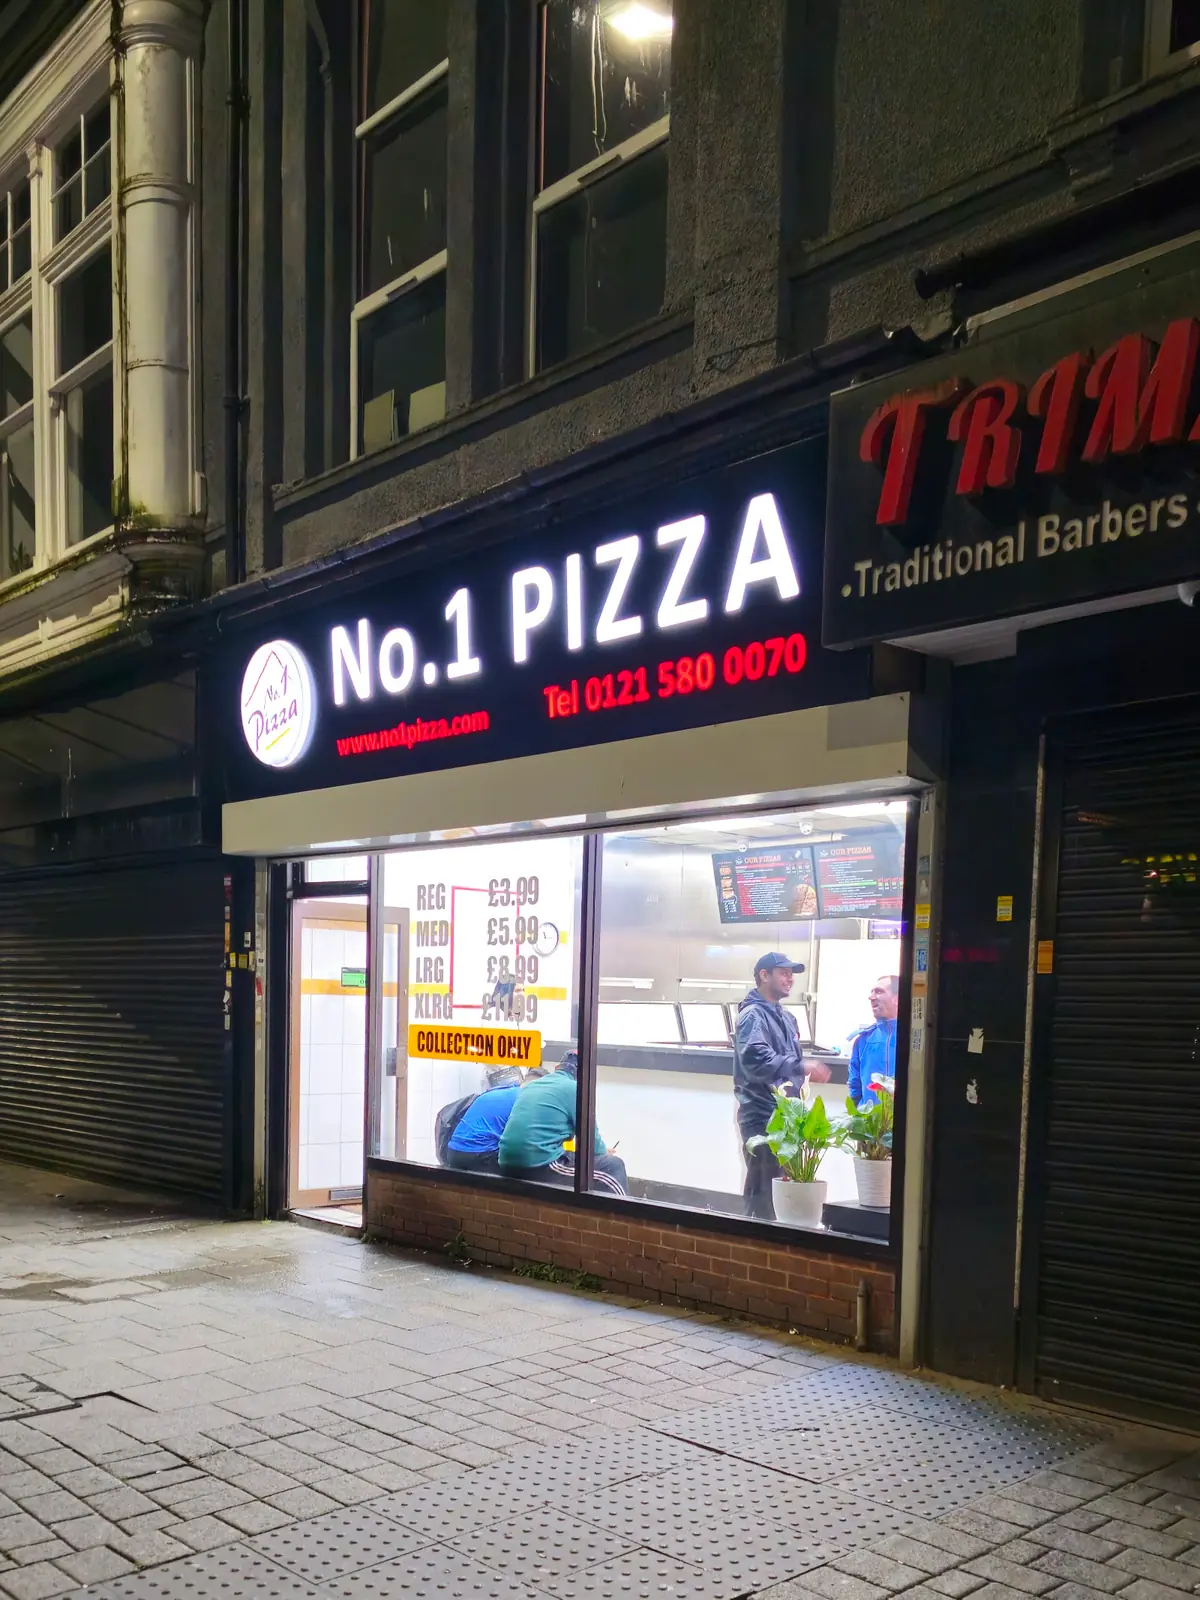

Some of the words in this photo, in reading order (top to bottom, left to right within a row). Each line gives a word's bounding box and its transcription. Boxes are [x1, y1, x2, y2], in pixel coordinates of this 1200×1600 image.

[860, 317, 1200, 526] TRIM
[854, 520, 1026, 597] Traditional
[1037, 493, 1189, 557] Barbers
[330, 587, 482, 706] No.1
[511, 492, 801, 664] PIZZA
[543, 679, 579, 719] Tel
[584, 666, 650, 710] 0121
[657, 655, 716, 698] 580
[723, 632, 808, 685] 0070
[248, 699, 298, 752] Pizza
[336, 710, 489, 757] www.no1pizza.com
[416, 883, 446, 911] REG
[488, 876, 540, 908] £3.99
[416, 920, 450, 948] MED
[487, 915, 539, 946] £5.99
[415, 956, 445, 984] LRG
[487, 955, 539, 984] £8.99
[414, 992, 453, 1020] XLRG
[481, 991, 538, 1023] £11.99
[417, 1030, 494, 1058] COLLECTION
[497, 1034, 532, 1060] ONLY
